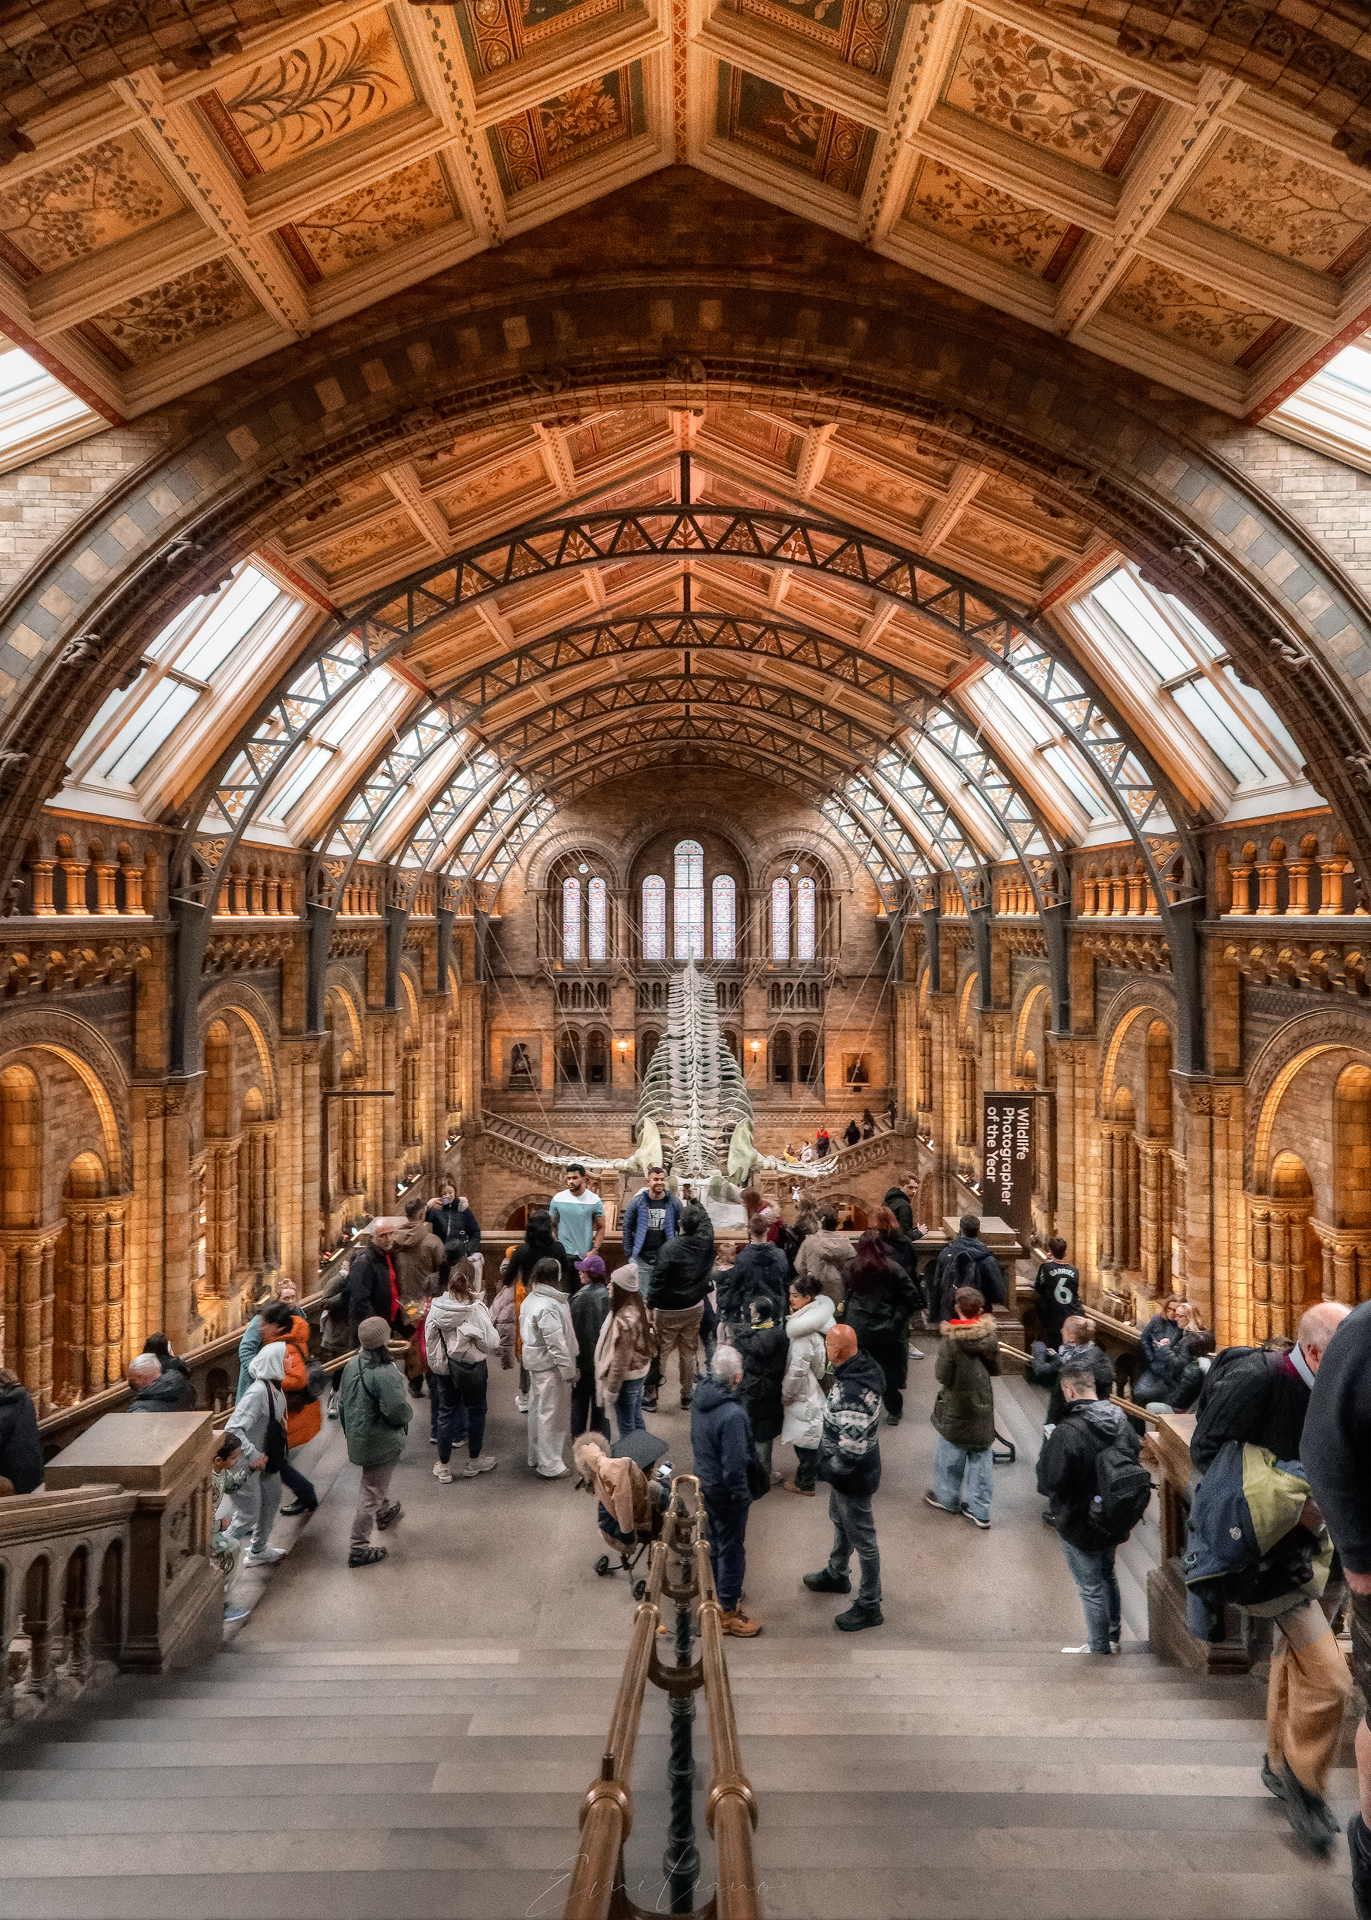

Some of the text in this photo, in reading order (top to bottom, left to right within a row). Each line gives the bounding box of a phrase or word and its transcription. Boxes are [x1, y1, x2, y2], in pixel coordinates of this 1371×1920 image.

[986, 1106, 1000, 1182] of the Year
[999, 1107, 1015, 1205] Photographer
[1016, 1107, 1030, 1160] Wildlife
[1054, 1277, 1073, 1304] 6
